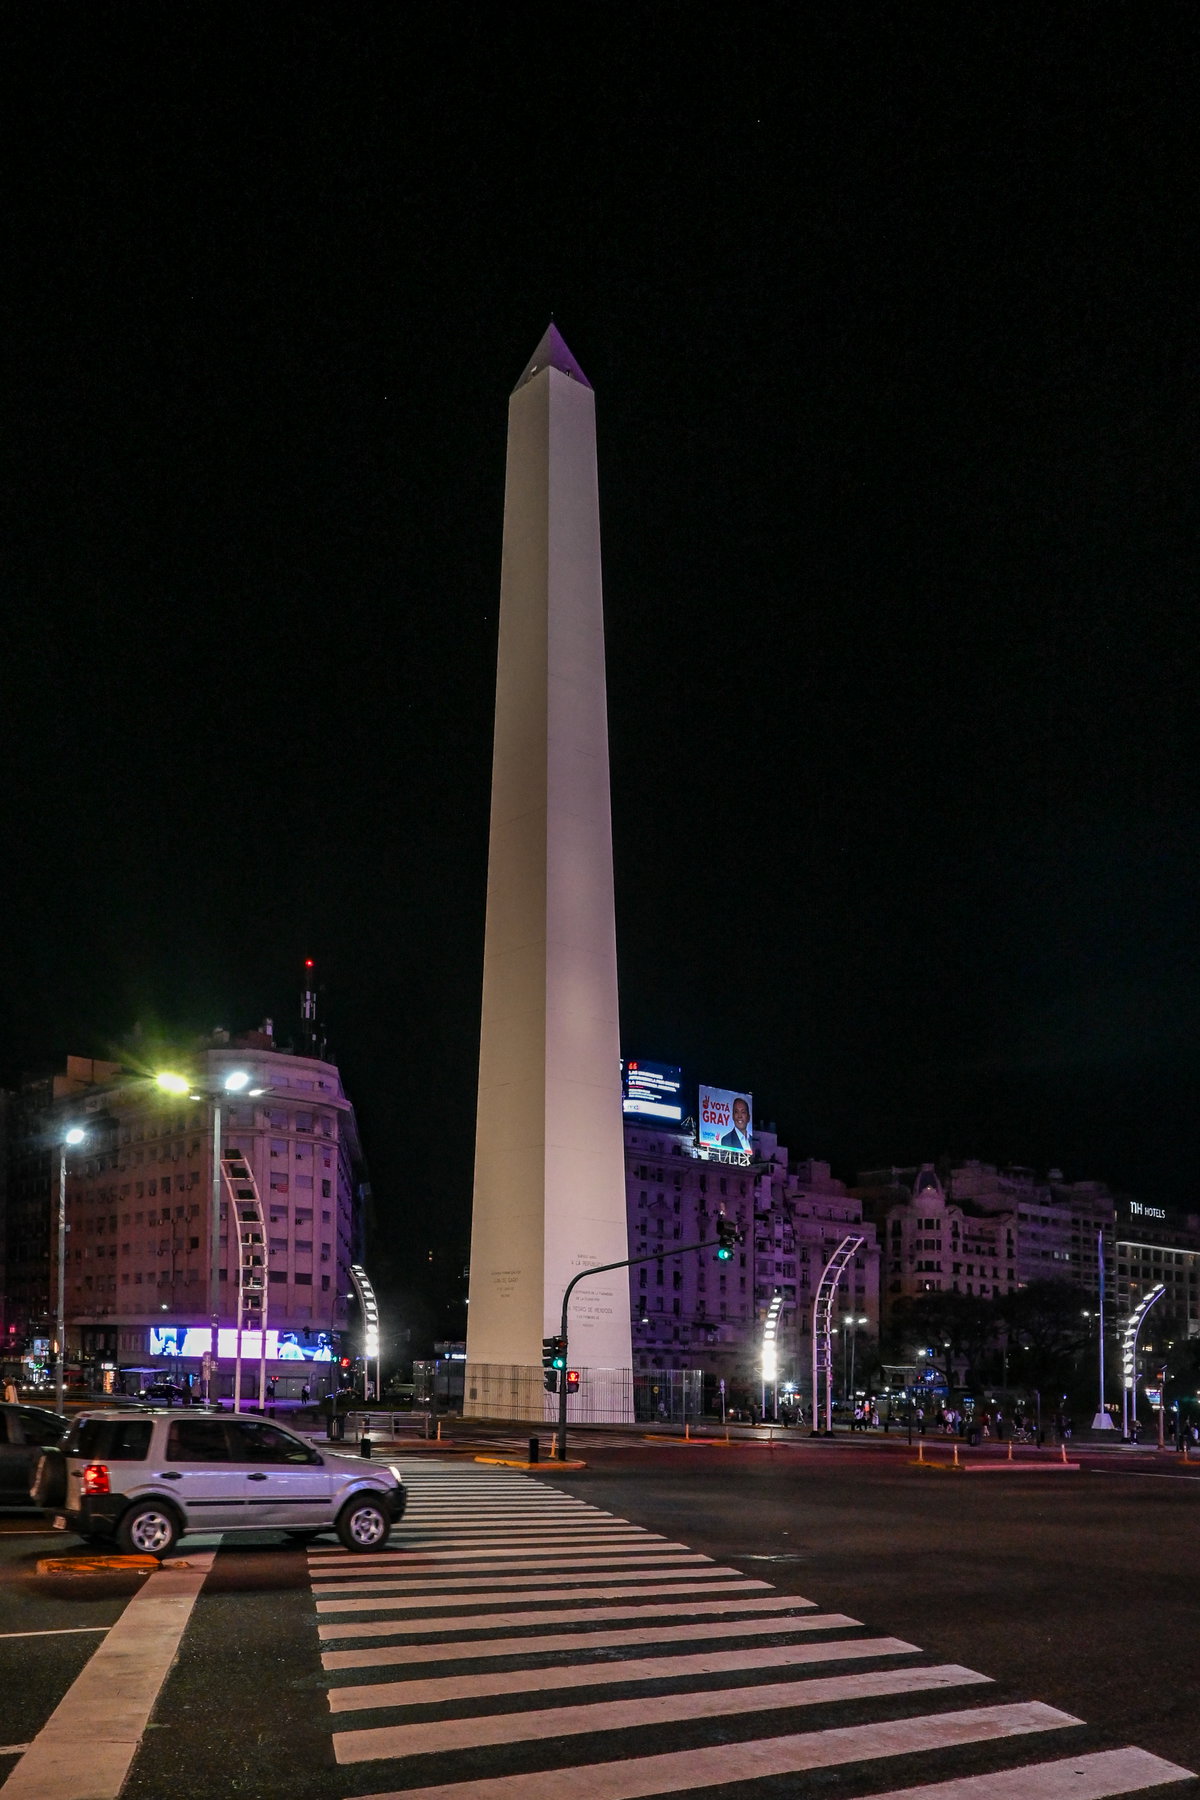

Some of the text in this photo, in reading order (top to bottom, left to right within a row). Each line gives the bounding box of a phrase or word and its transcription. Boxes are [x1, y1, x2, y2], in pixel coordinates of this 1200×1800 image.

[710, 1101, 730, 1112] VOTÁ
[702, 1110, 730, 1126] GRAY
[1144, 1207, 1166, 1219] HOTELS
